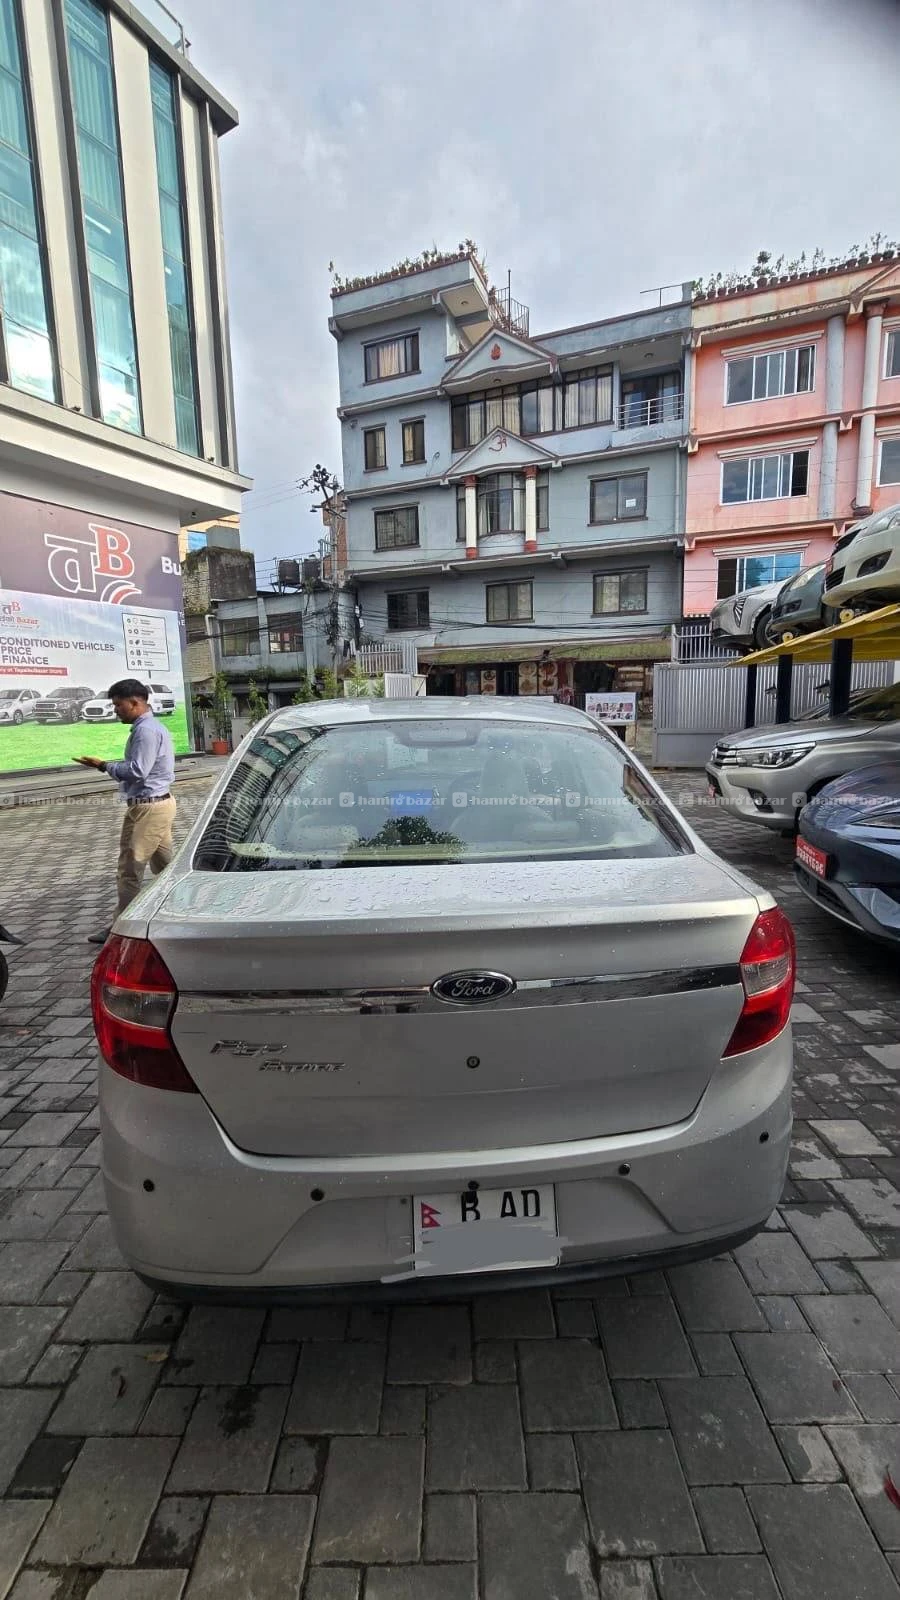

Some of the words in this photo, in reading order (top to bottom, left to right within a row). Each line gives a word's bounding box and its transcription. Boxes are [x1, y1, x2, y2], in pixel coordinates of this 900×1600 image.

[1, 646, 32, 656] PRICE
[71, 641, 115, 652] VEHICLES
[2, 655, 49, 665] FINANCE
[451, 978, 496, 997] Ford
